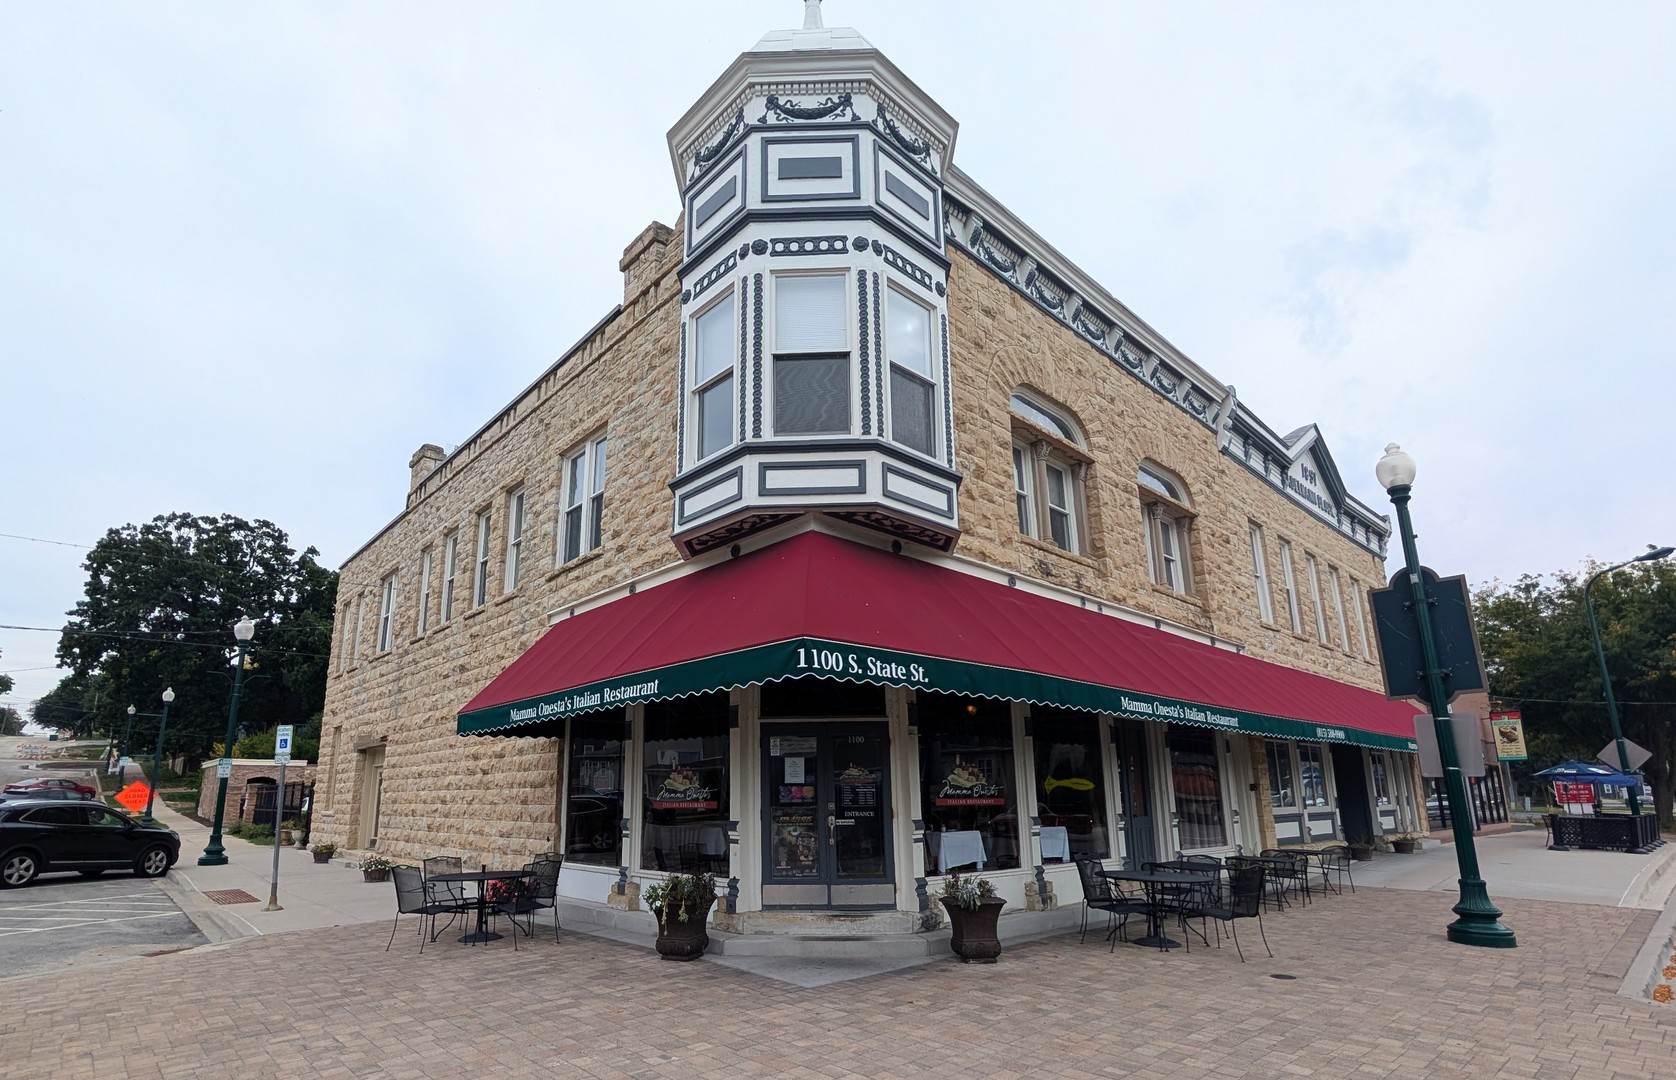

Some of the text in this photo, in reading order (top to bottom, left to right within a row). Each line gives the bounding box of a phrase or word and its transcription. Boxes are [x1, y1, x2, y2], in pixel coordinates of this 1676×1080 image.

[797, 648, 929, 683] 1100 S. State St.
[510, 678, 659, 722] Mamma Onesta's Italian Restaurant
[1120, 696, 1239, 727] Mamma Onesta's Italian Restaurant
